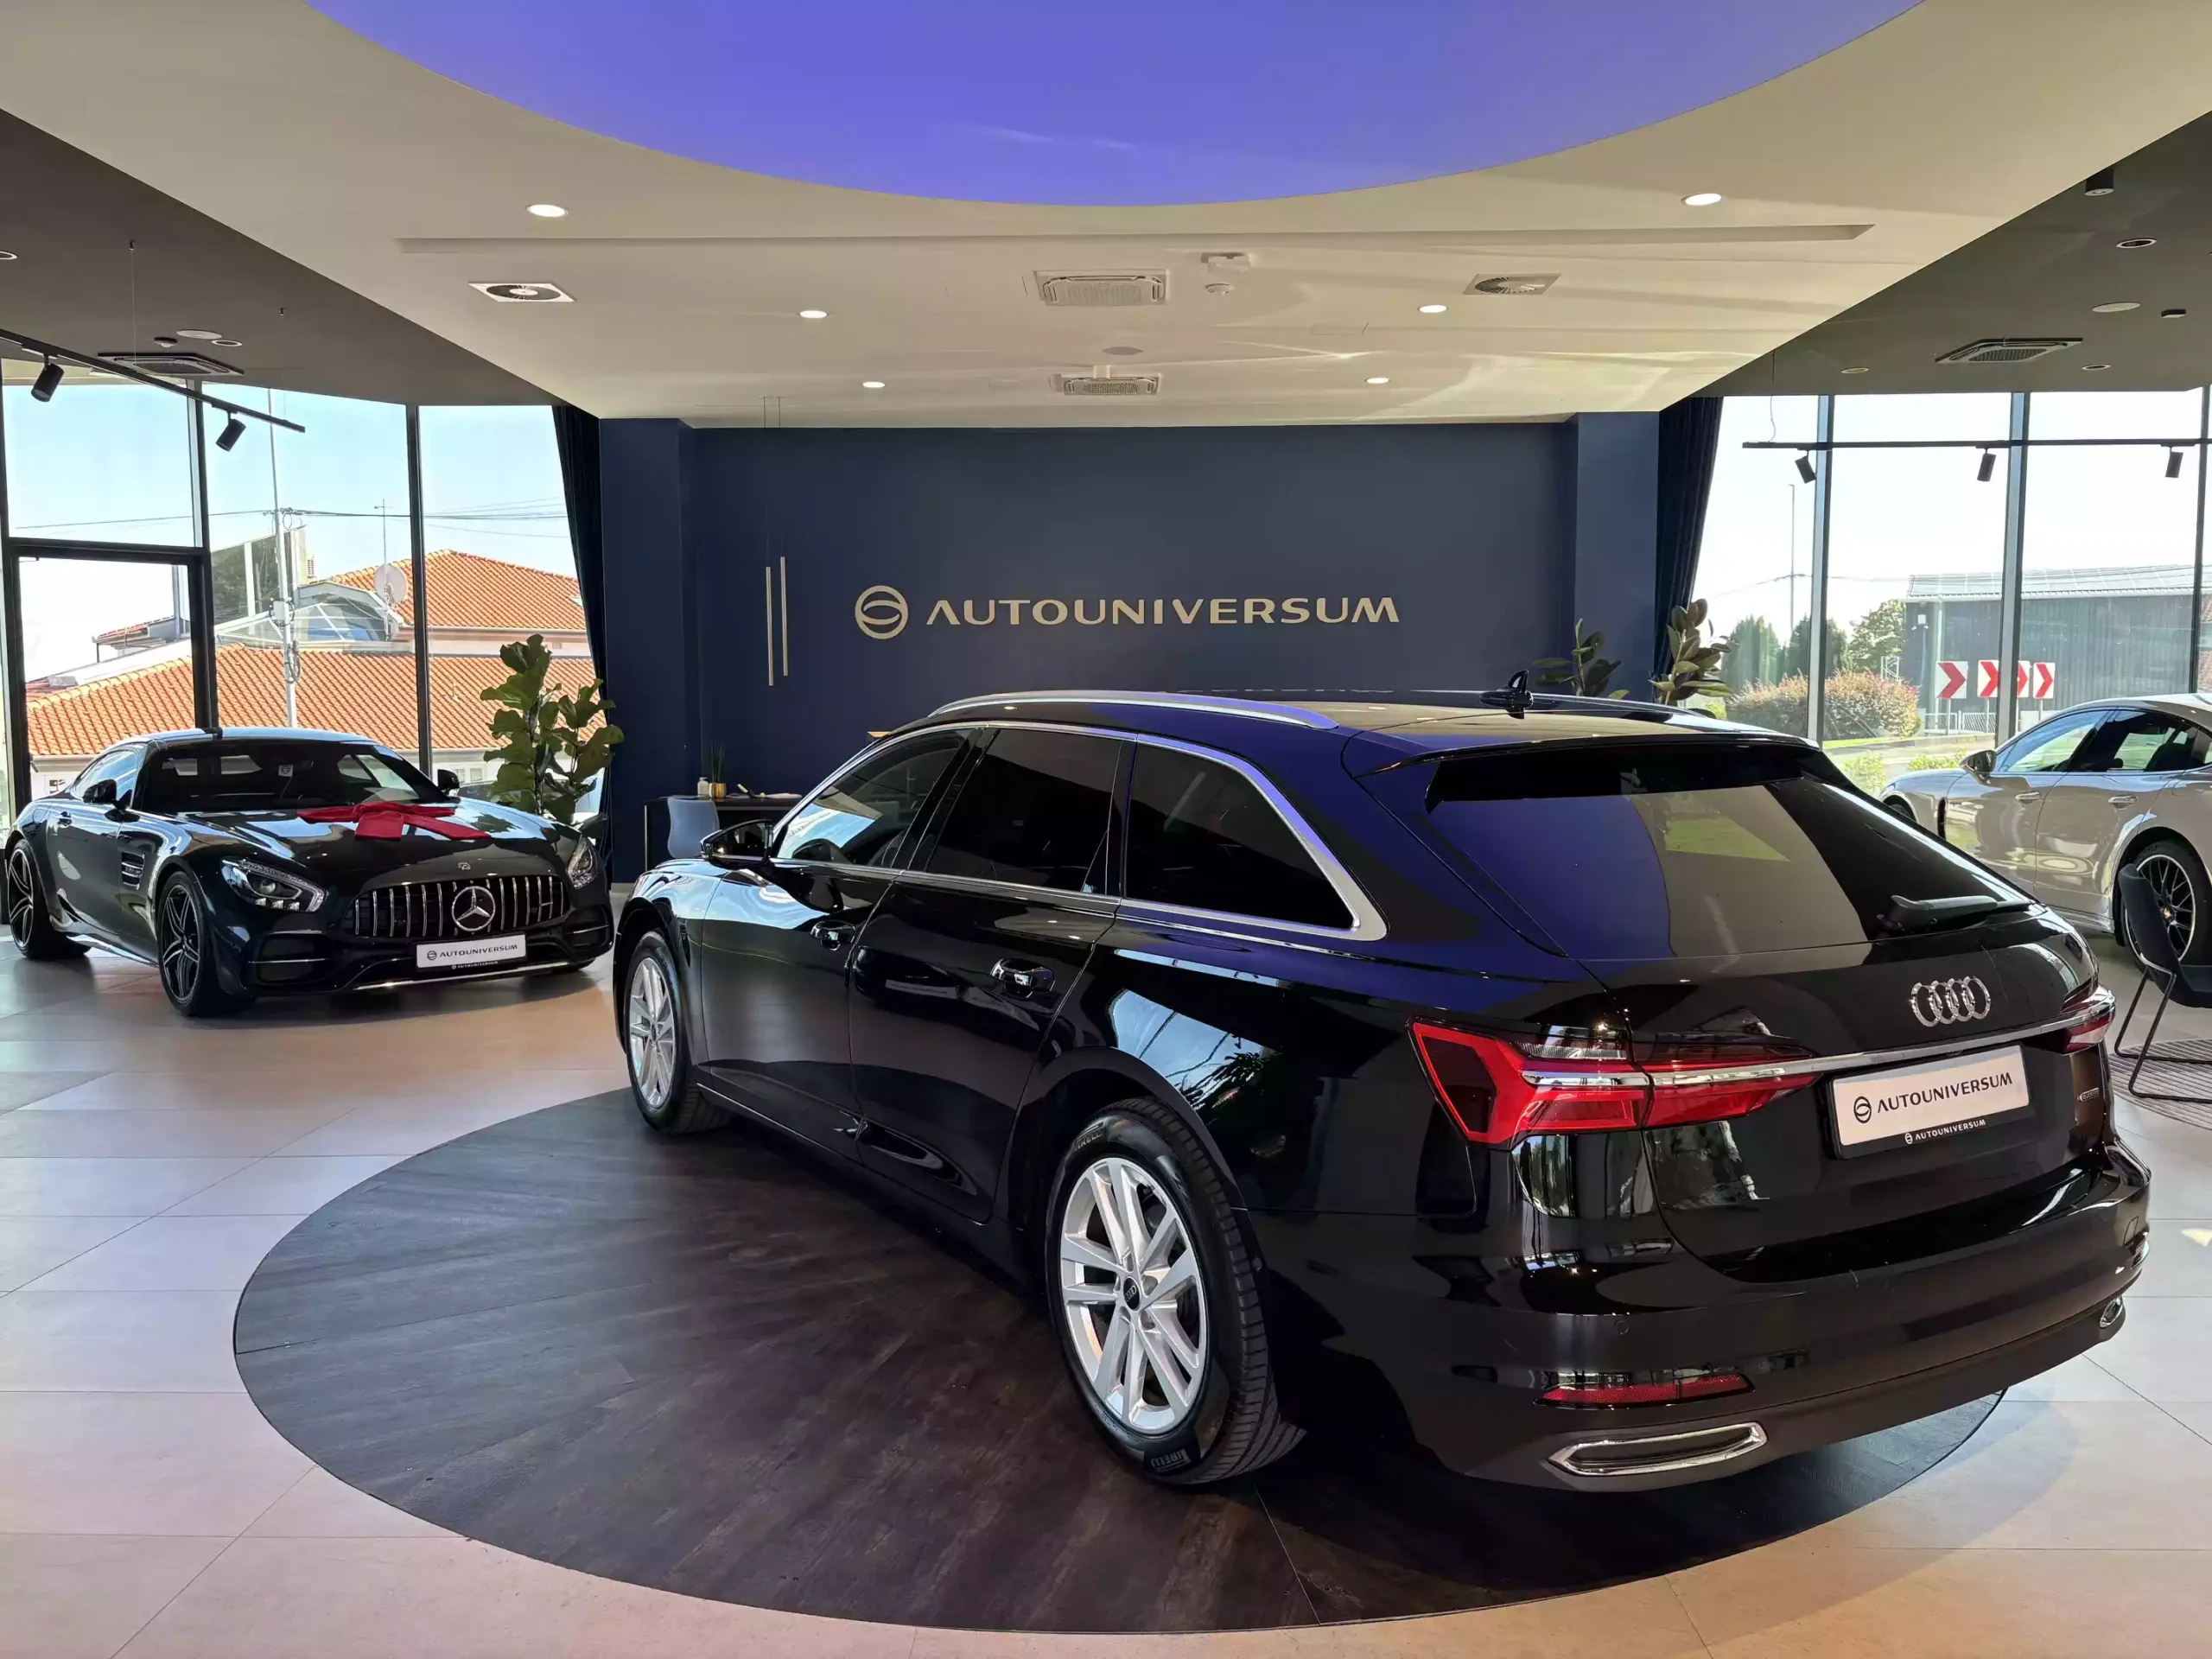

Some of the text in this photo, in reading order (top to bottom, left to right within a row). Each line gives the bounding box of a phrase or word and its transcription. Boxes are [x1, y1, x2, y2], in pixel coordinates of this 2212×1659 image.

[926, 597, 1400, 625] AUTOUNIVERSUM
[439, 944, 518, 957] AUTOUNIVERSUM
[1878, 1072, 2012, 1113] AUTOUNIVERSUM
[1916, 1119, 1986, 1140] AUTOUNIVERSUM
